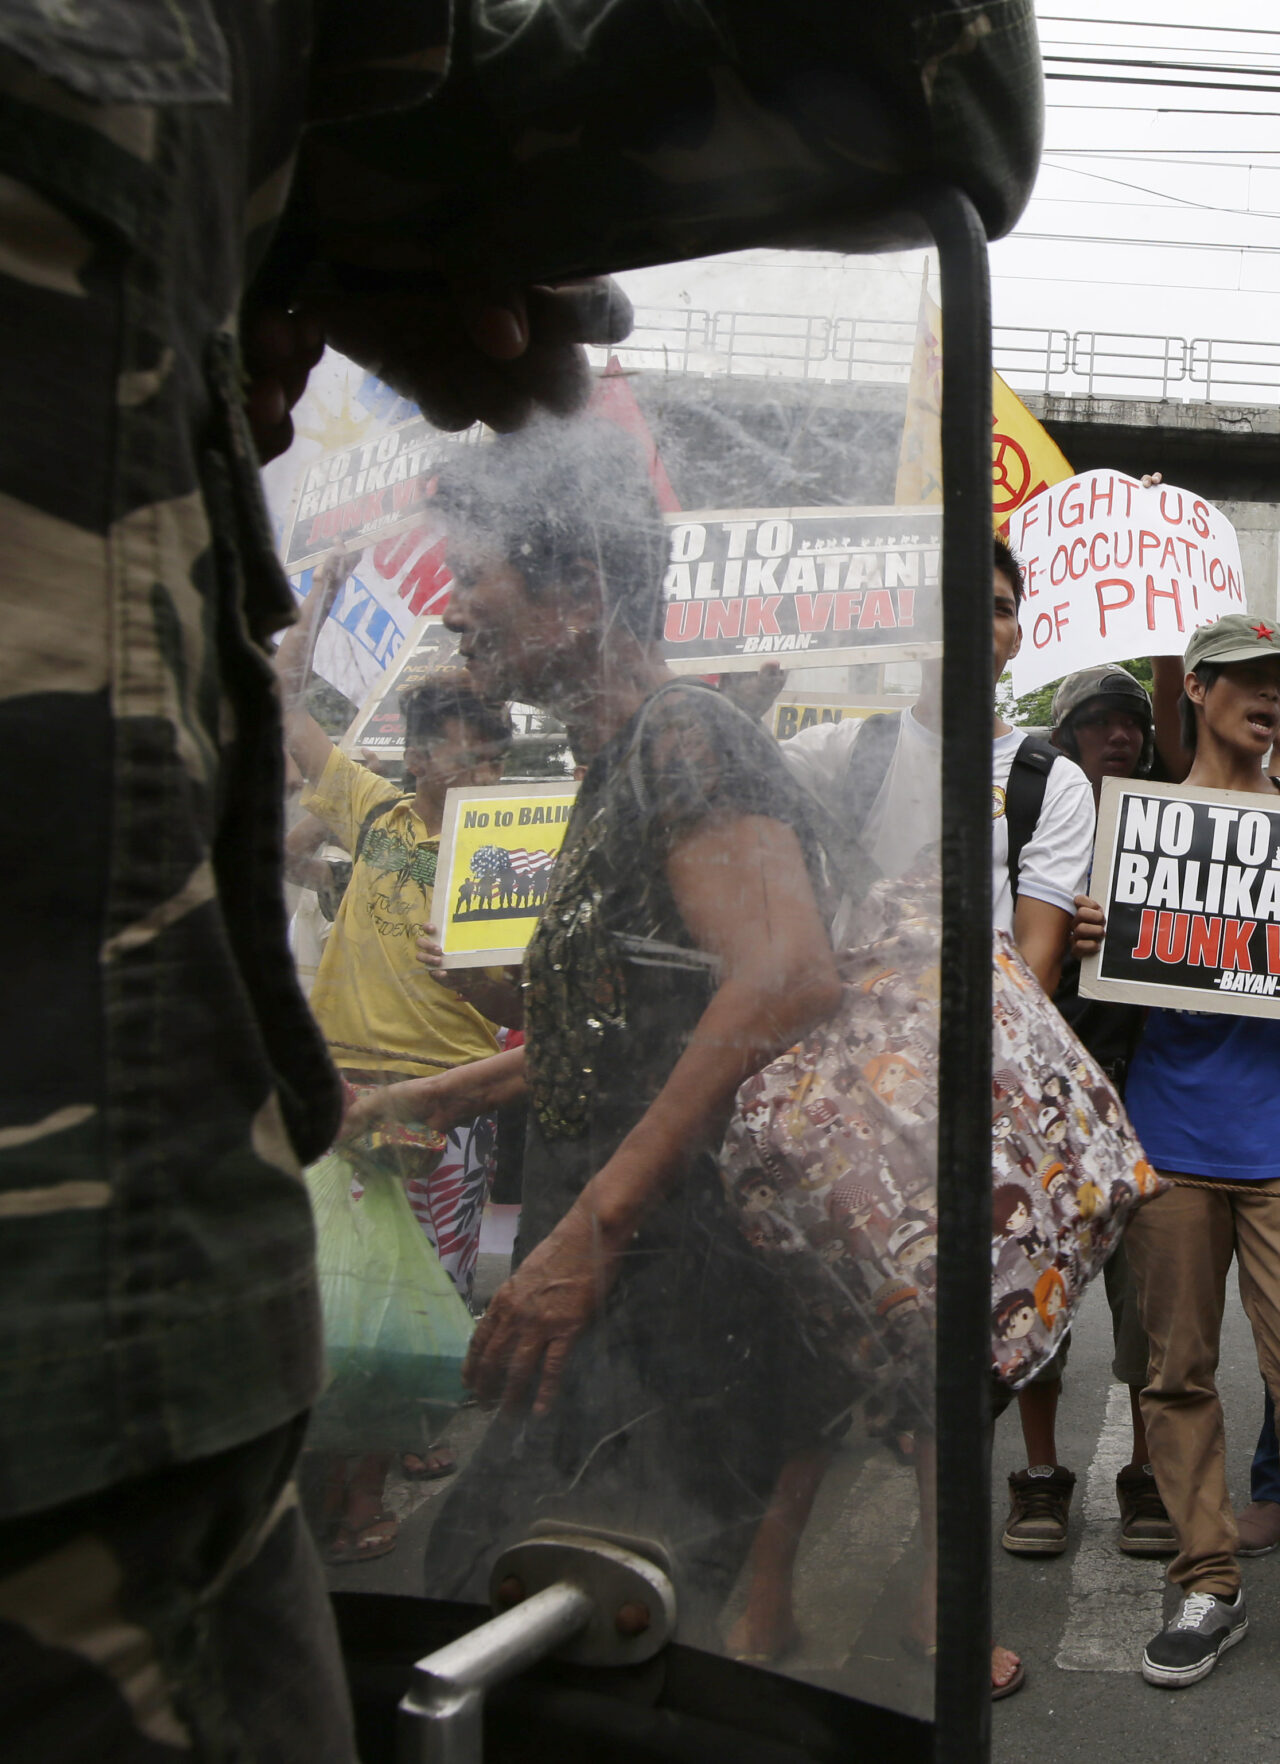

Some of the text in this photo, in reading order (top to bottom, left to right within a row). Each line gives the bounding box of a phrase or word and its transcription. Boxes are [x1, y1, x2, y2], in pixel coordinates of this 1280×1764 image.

[306, 432, 400, 493] NO TO
[671, 519, 794, 562] O TO
[1020, 476, 1215, 552] FIGHT U.S.
[664, 550, 940, 600] ALIKATAN!
[663, 589, 916, 643] UNK VFA!
[1033, 574, 1200, 649] OF PH!
[735, 632, 818, 653] -BAYAN-
[464, 809, 489, 828] No
[494, 809, 514, 827] to
[1123, 797, 1271, 866] NO TO
[1131, 908, 1258, 973] JUNK
